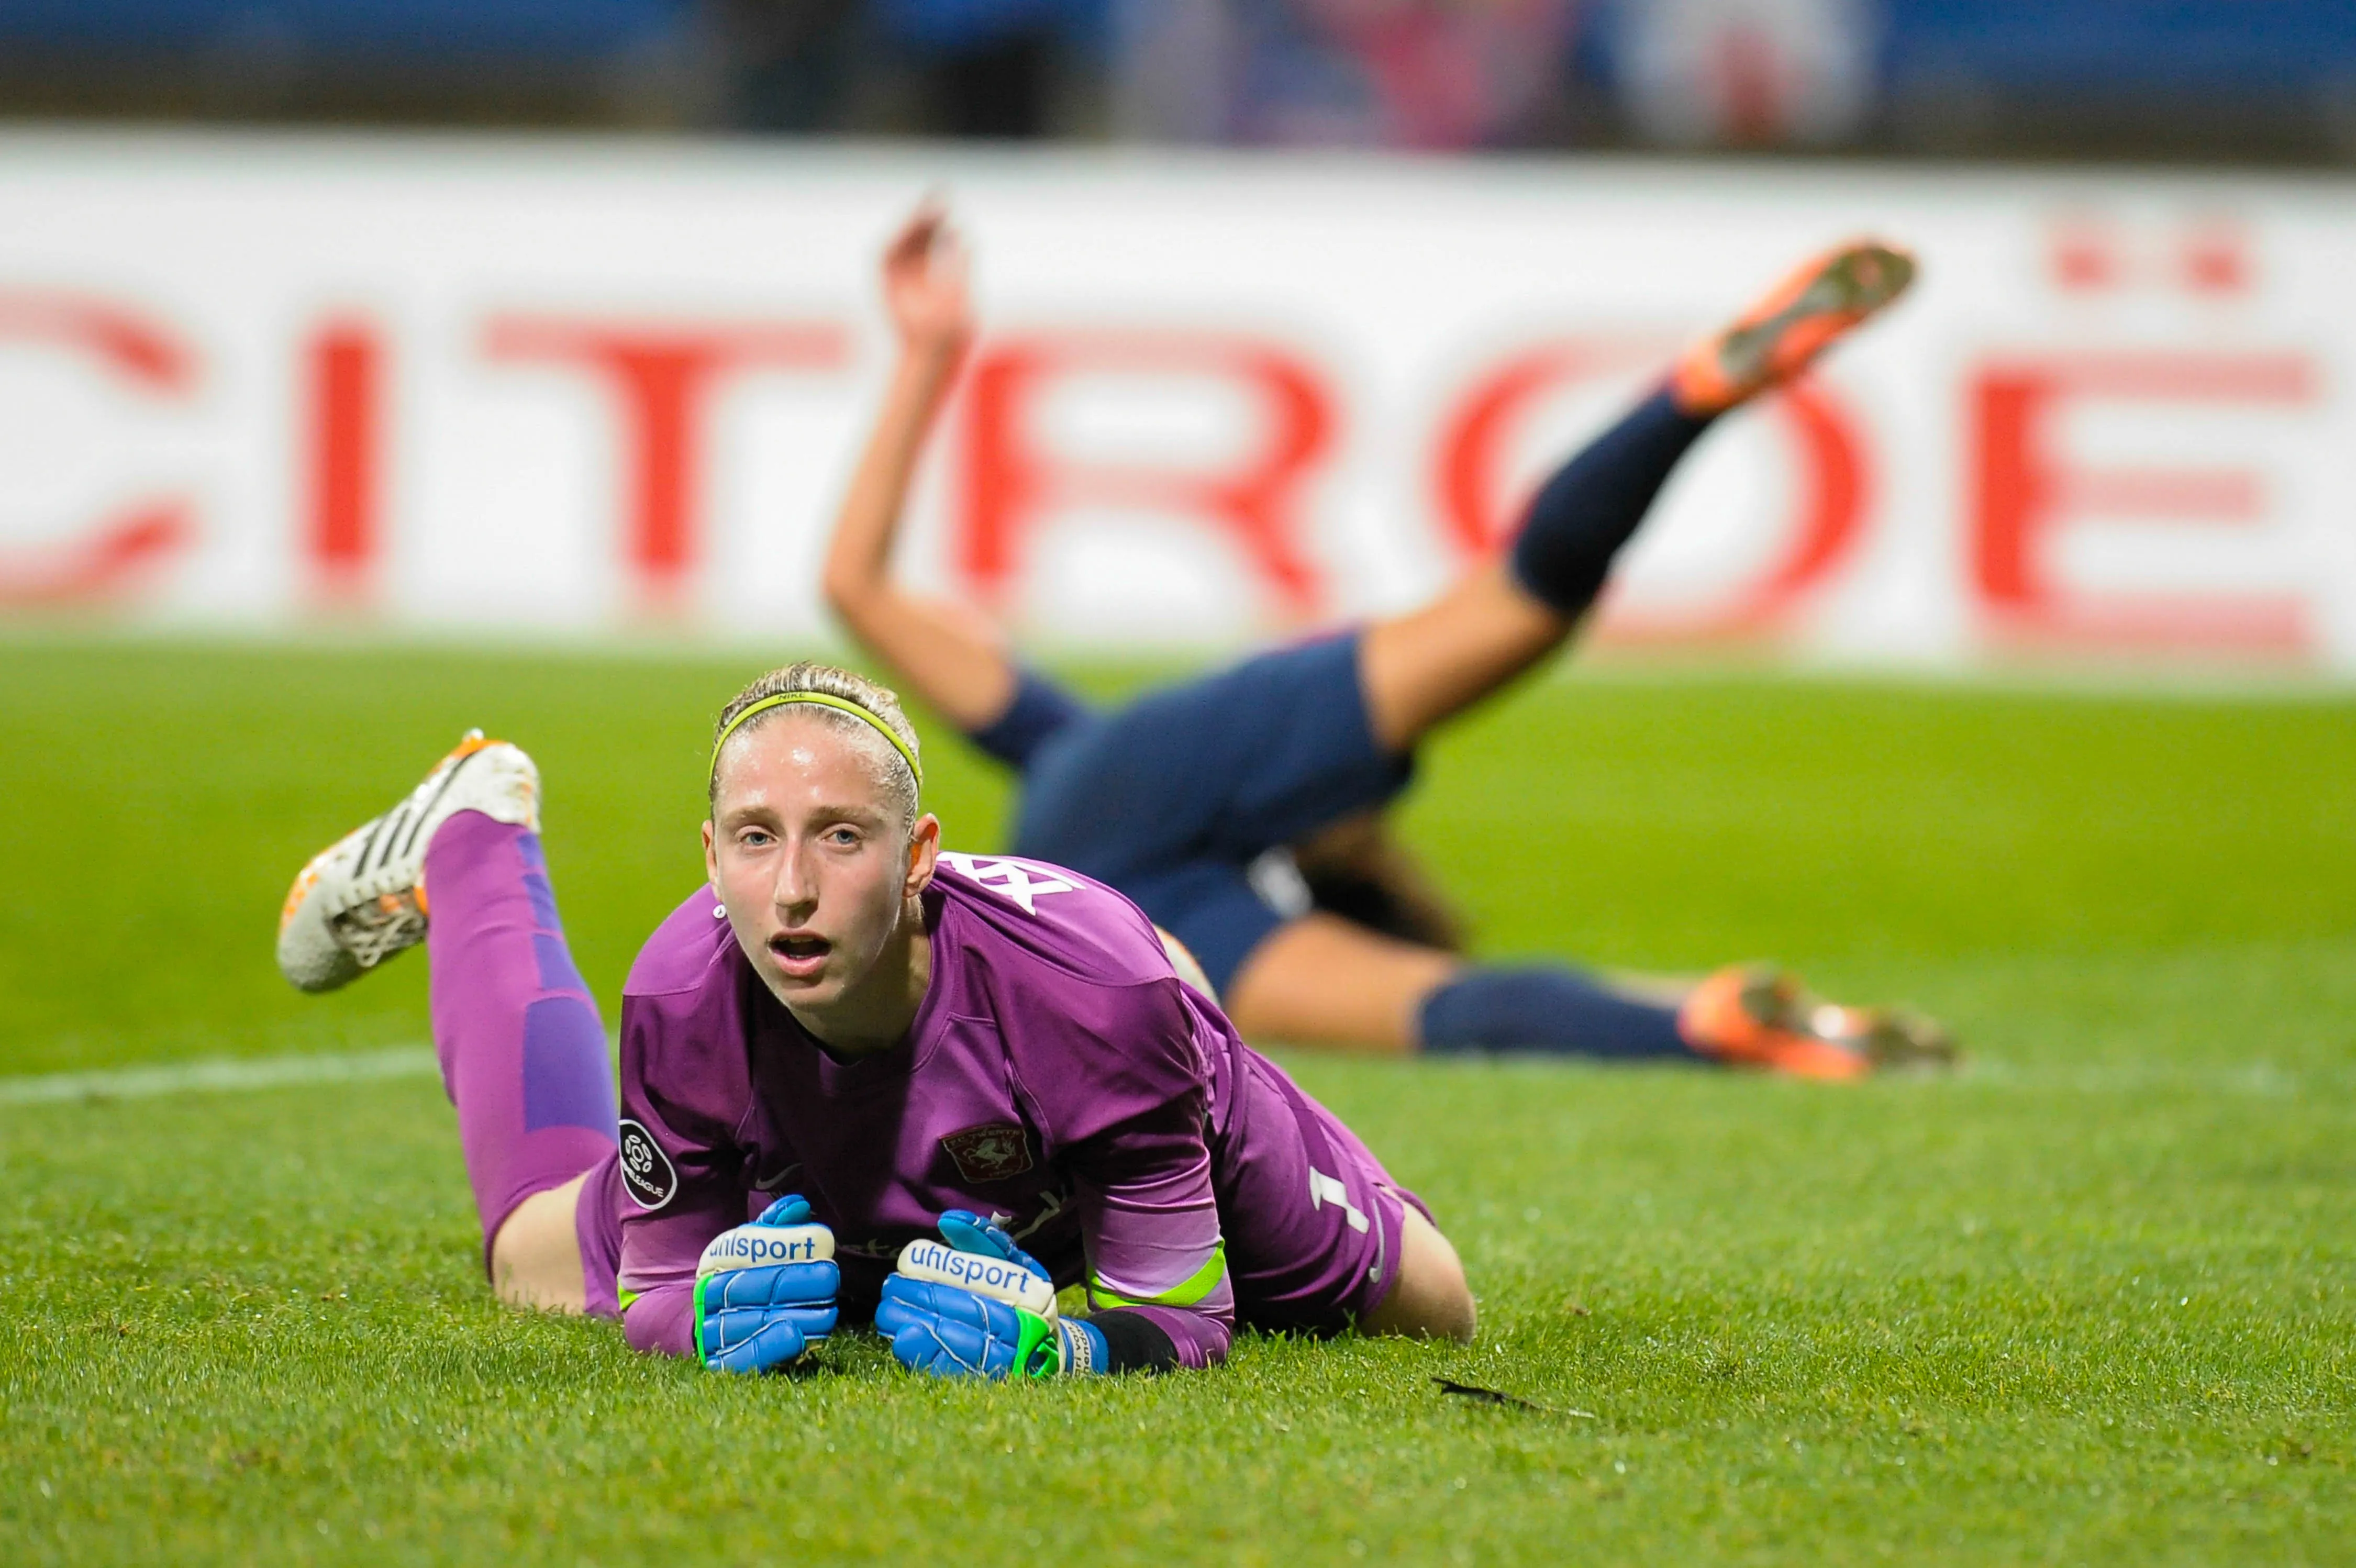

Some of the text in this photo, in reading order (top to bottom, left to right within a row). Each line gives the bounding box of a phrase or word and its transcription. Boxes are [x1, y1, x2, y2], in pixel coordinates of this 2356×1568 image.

[778, 693, 805, 701] NIKE
[709, 1232, 815, 1263] uhlsport
[910, 1245, 1030, 1293] uhlsport
